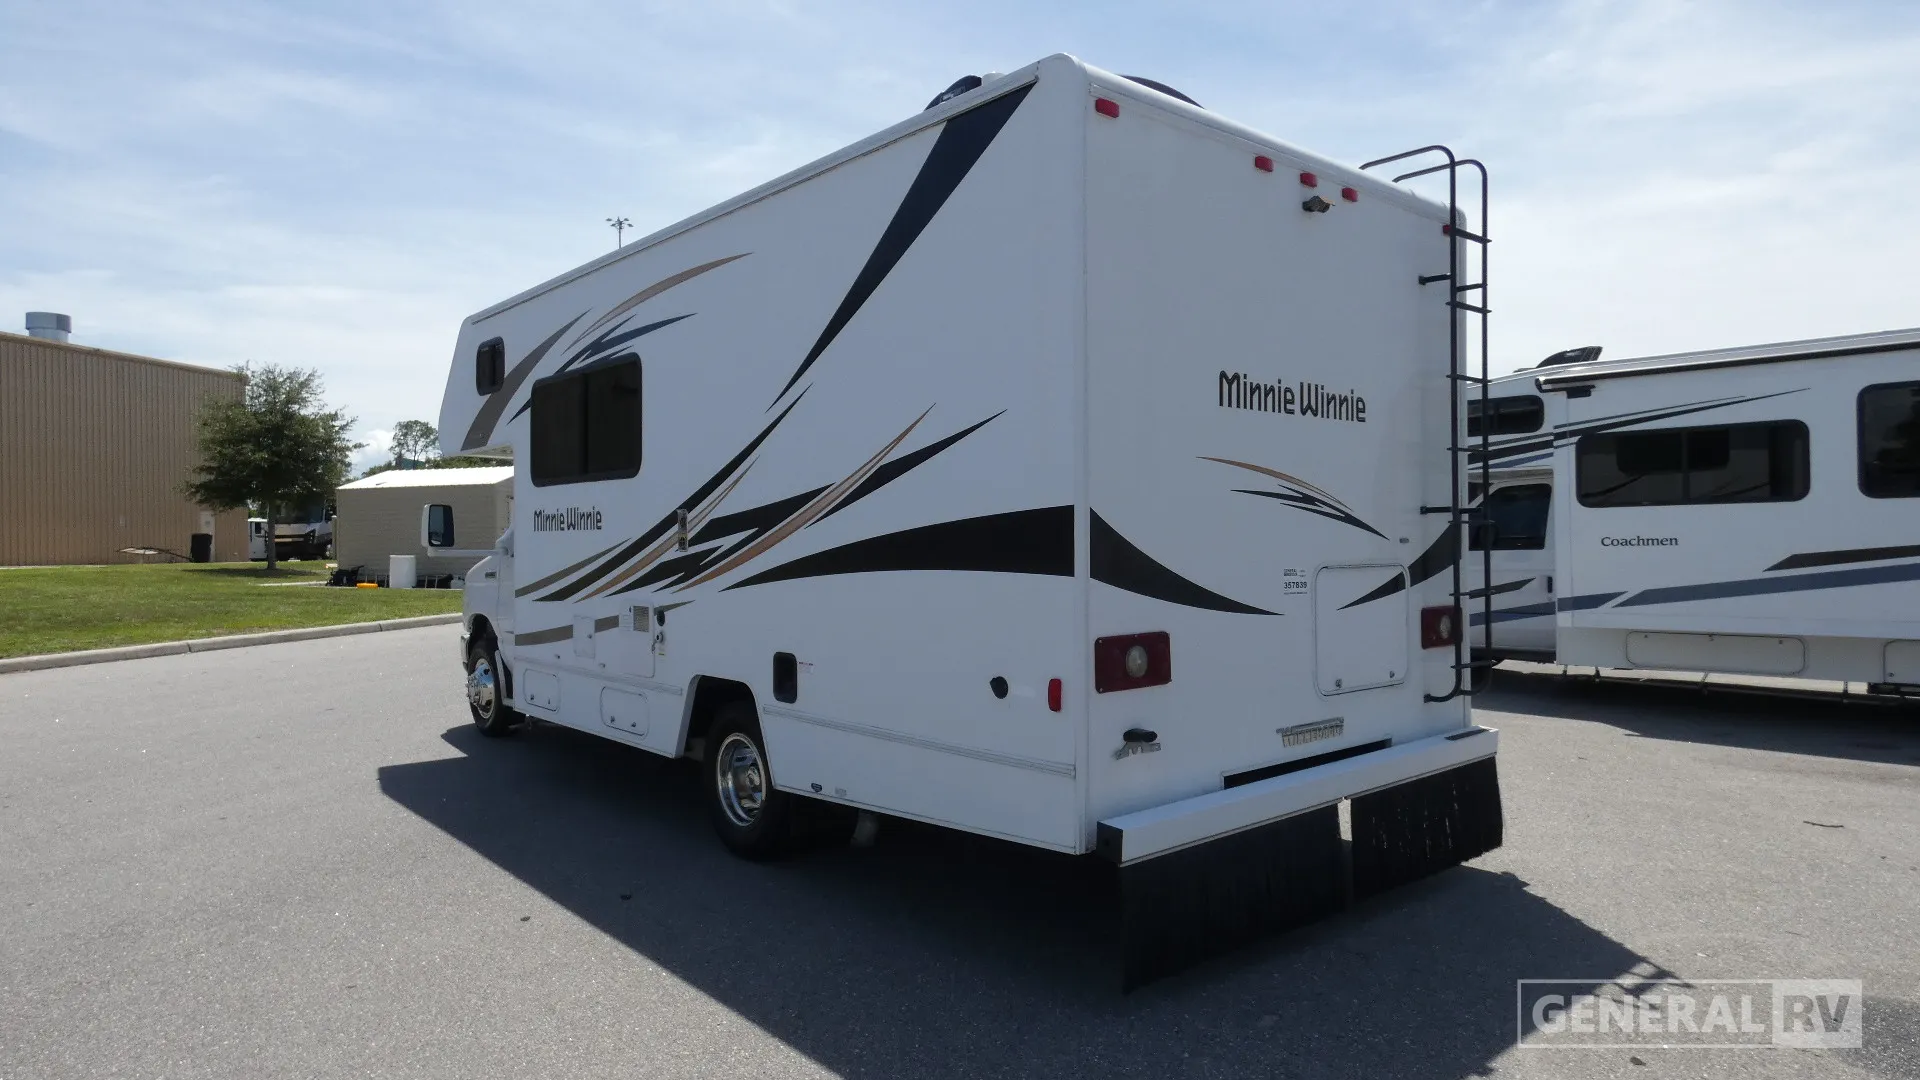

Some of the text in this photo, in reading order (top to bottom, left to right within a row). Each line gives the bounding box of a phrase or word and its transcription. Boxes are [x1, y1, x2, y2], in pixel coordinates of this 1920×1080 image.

[1219, 370, 1366, 422] Minnie Winnie
[532, 504, 602, 532] Minnie Winnie
[1601, 535, 1679, 547] Coachmen
